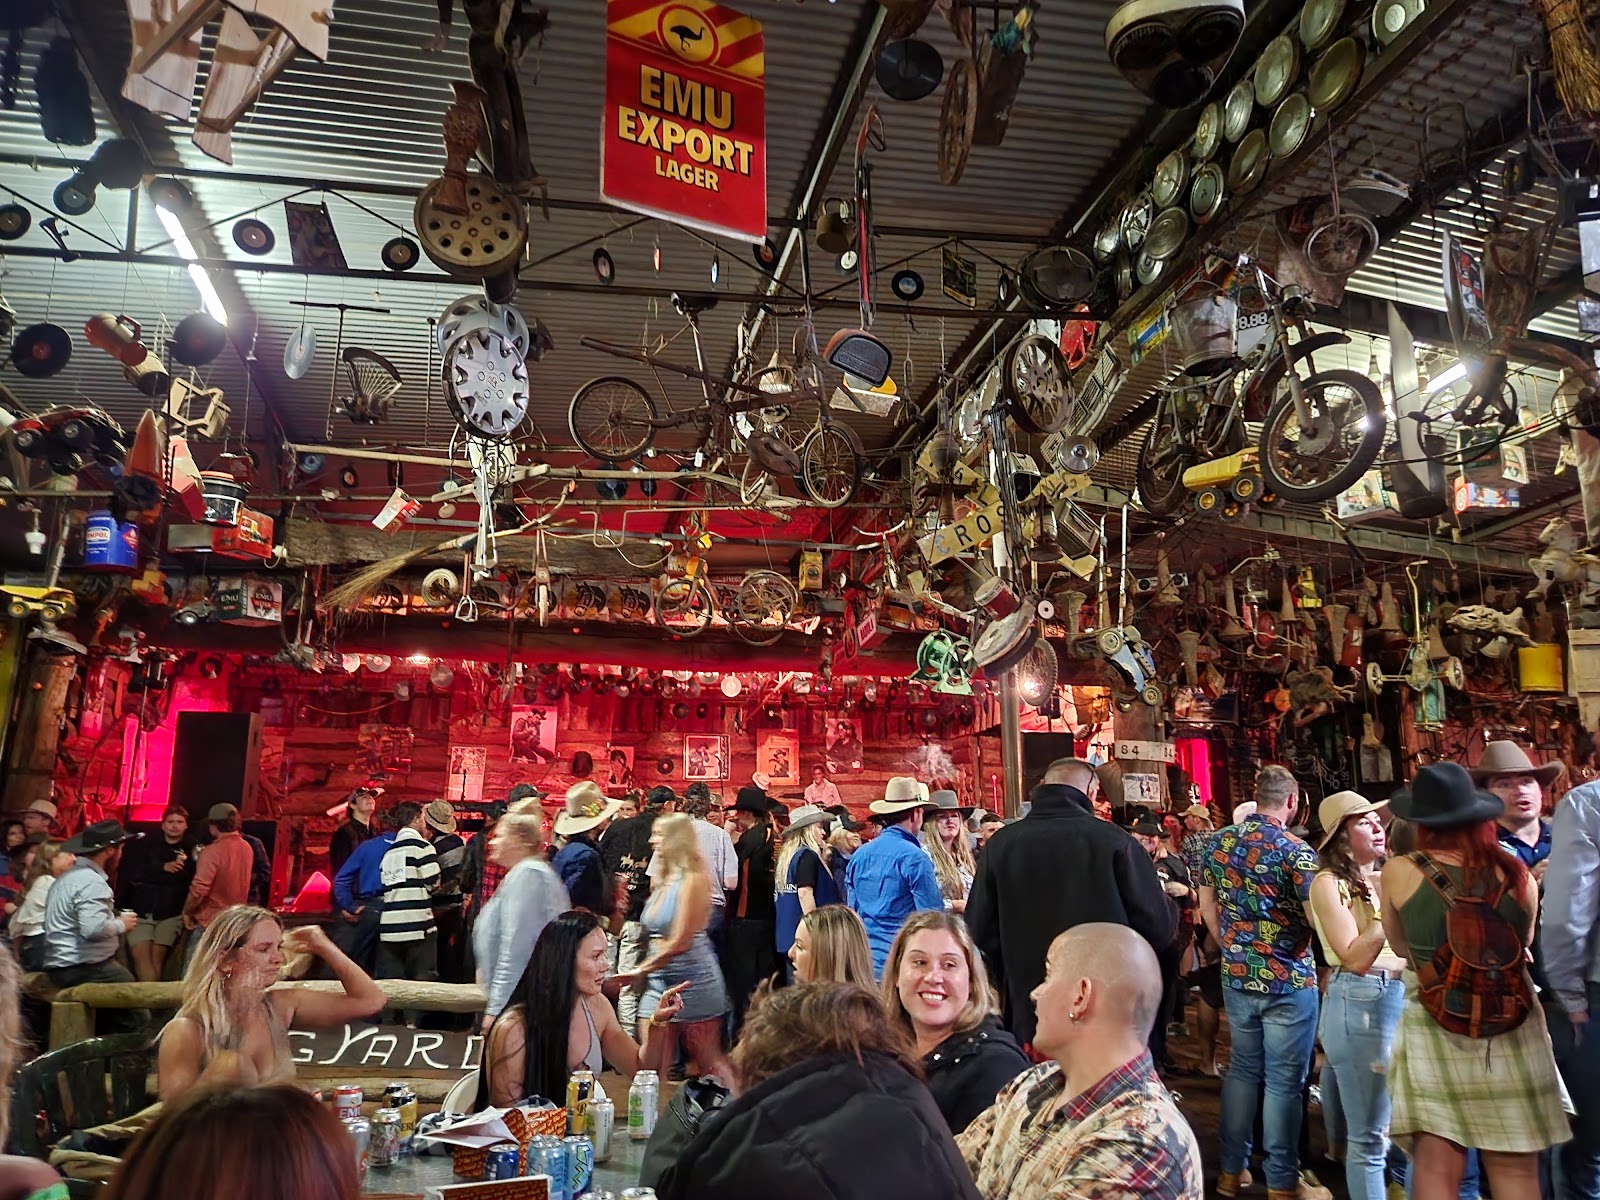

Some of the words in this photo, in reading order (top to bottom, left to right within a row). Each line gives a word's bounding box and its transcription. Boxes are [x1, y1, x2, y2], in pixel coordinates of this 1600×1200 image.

[641, 64, 732, 130] EMU
[619, 105, 754, 175] EXPORT
[655, 155, 719, 191] LAGER
